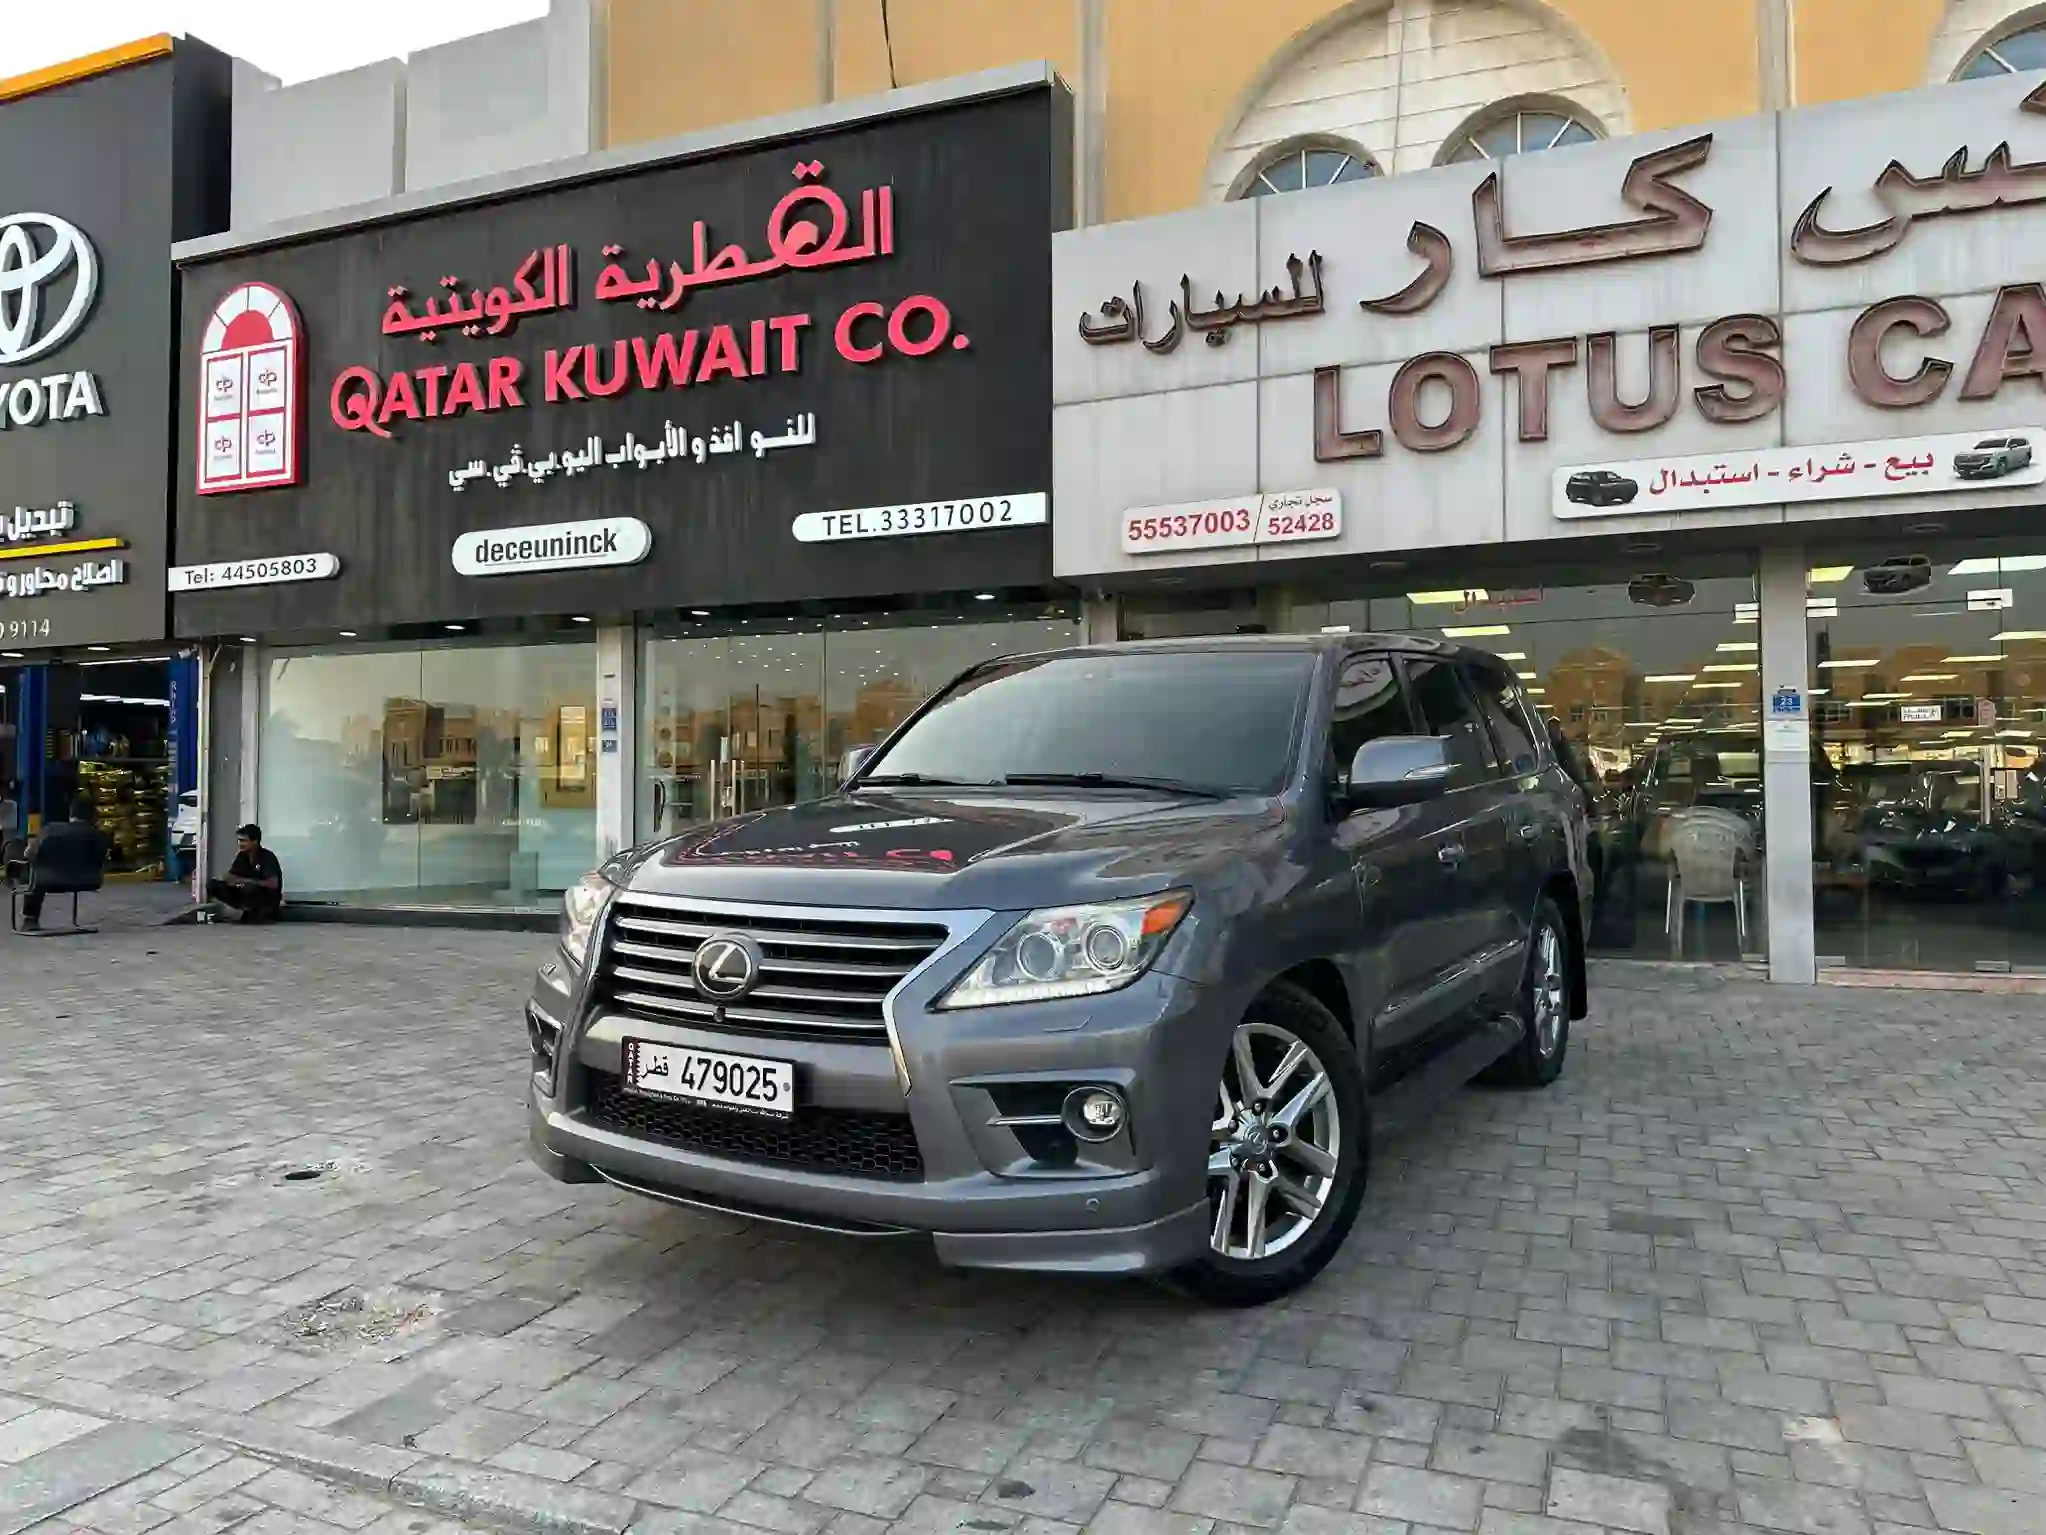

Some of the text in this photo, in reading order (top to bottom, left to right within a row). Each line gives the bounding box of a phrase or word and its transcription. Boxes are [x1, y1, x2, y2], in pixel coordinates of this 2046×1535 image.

[1359, 132, 1714, 315] كار
[380, 158, 894, 343] القطرية الكويتية
[1079, 249, 1325, 354] للسيارات
[330, 293, 971, 440] QATAR KUWAIT CO.
[1314, 313, 1786, 464] LOTUS
[1649, 463, 1759, 495] استبدال
[1788, 451, 1856, 483] شراء
[1884, 451, 1935, 481] بيع
[1303, 494, 1333, 507] سجل
[7, 500, 74, 541] تبديل
[1128, 508, 1251, 541] 55537003
[1267, 512, 1334, 536] 52428
[475, 527, 617, 564] deceuninck
[19, 565, 69, 597] محاور
[185, 558, 317, 585] Tel: 44505803
[10, 618, 50, 638] 9114
[640, 1055, 669, 1079] قطر
[681, 1055, 778, 1102] 479025
